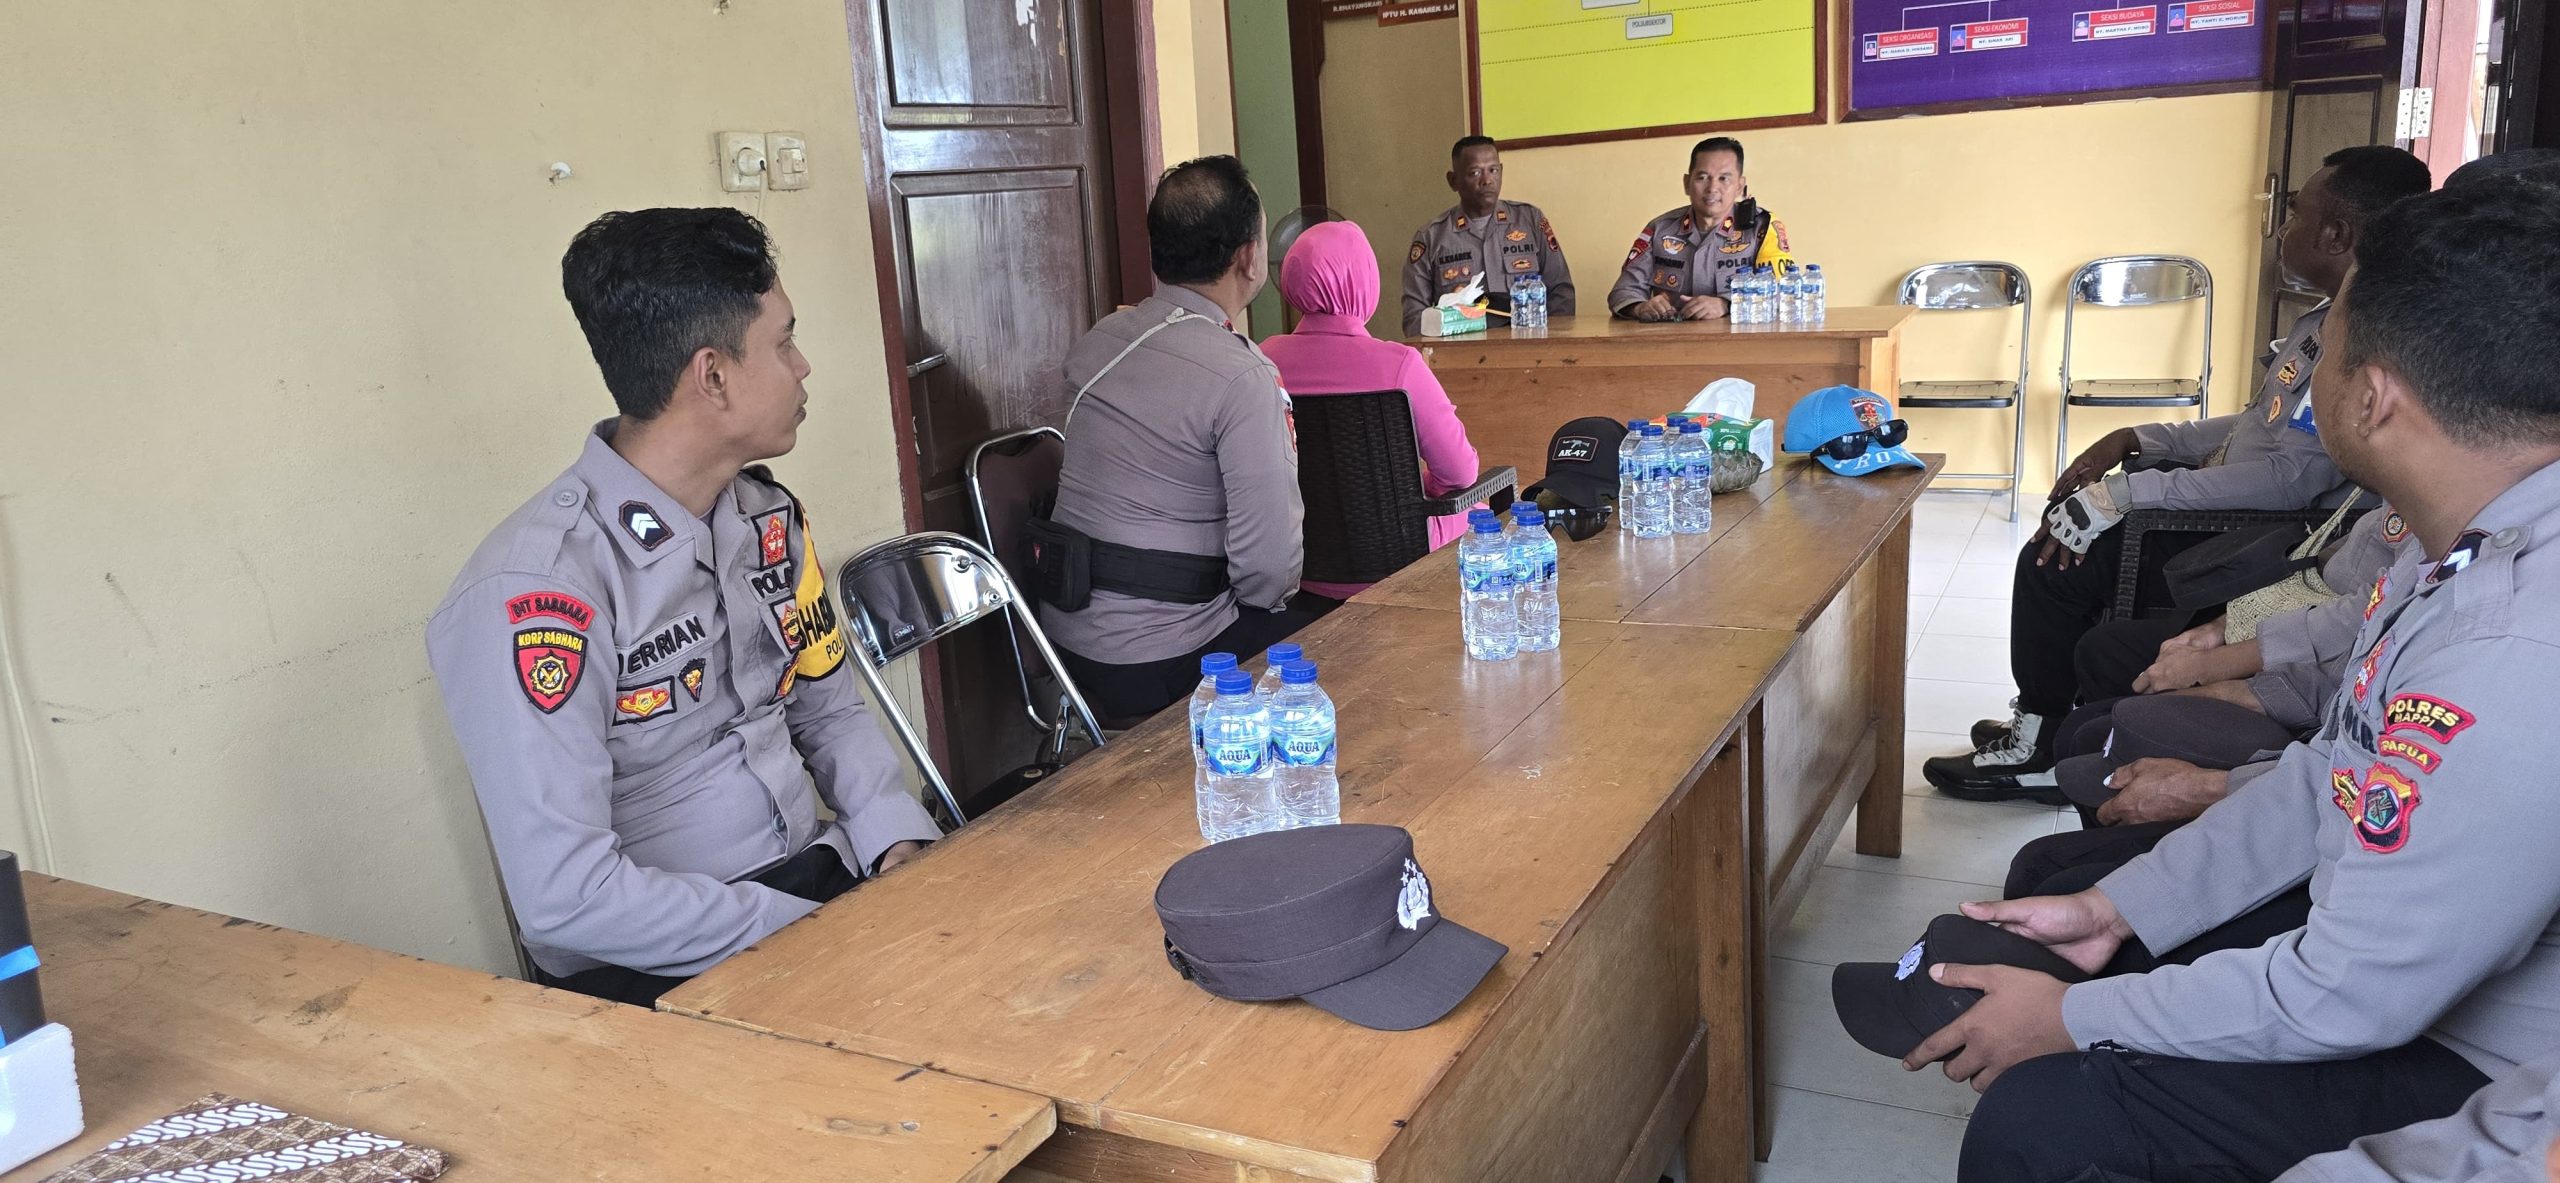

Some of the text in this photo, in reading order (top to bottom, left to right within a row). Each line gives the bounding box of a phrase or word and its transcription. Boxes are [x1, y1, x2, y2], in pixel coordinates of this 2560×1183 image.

[1382, 10, 1398, 19] IPTU
[2119, 10, 2145, 20] BUDAYA
[1973, 22, 2019, 34] SEKSI EKONOMI
[1503, 243, 1534, 254] POLRI
[1558, 449, 1588, 459] AK-47
[512, 599, 532, 618] DIT
[518, 632, 583, 652] KORP SABHARA
[2387, 699, 2459, 727] POLRES
[2394, 712, 2436, 728] MAPPI
[1287, 741, 1320, 754] AQUA
[2381, 739, 2430, 766] PAPUA
[1219, 749, 1251, 763] AQUA
